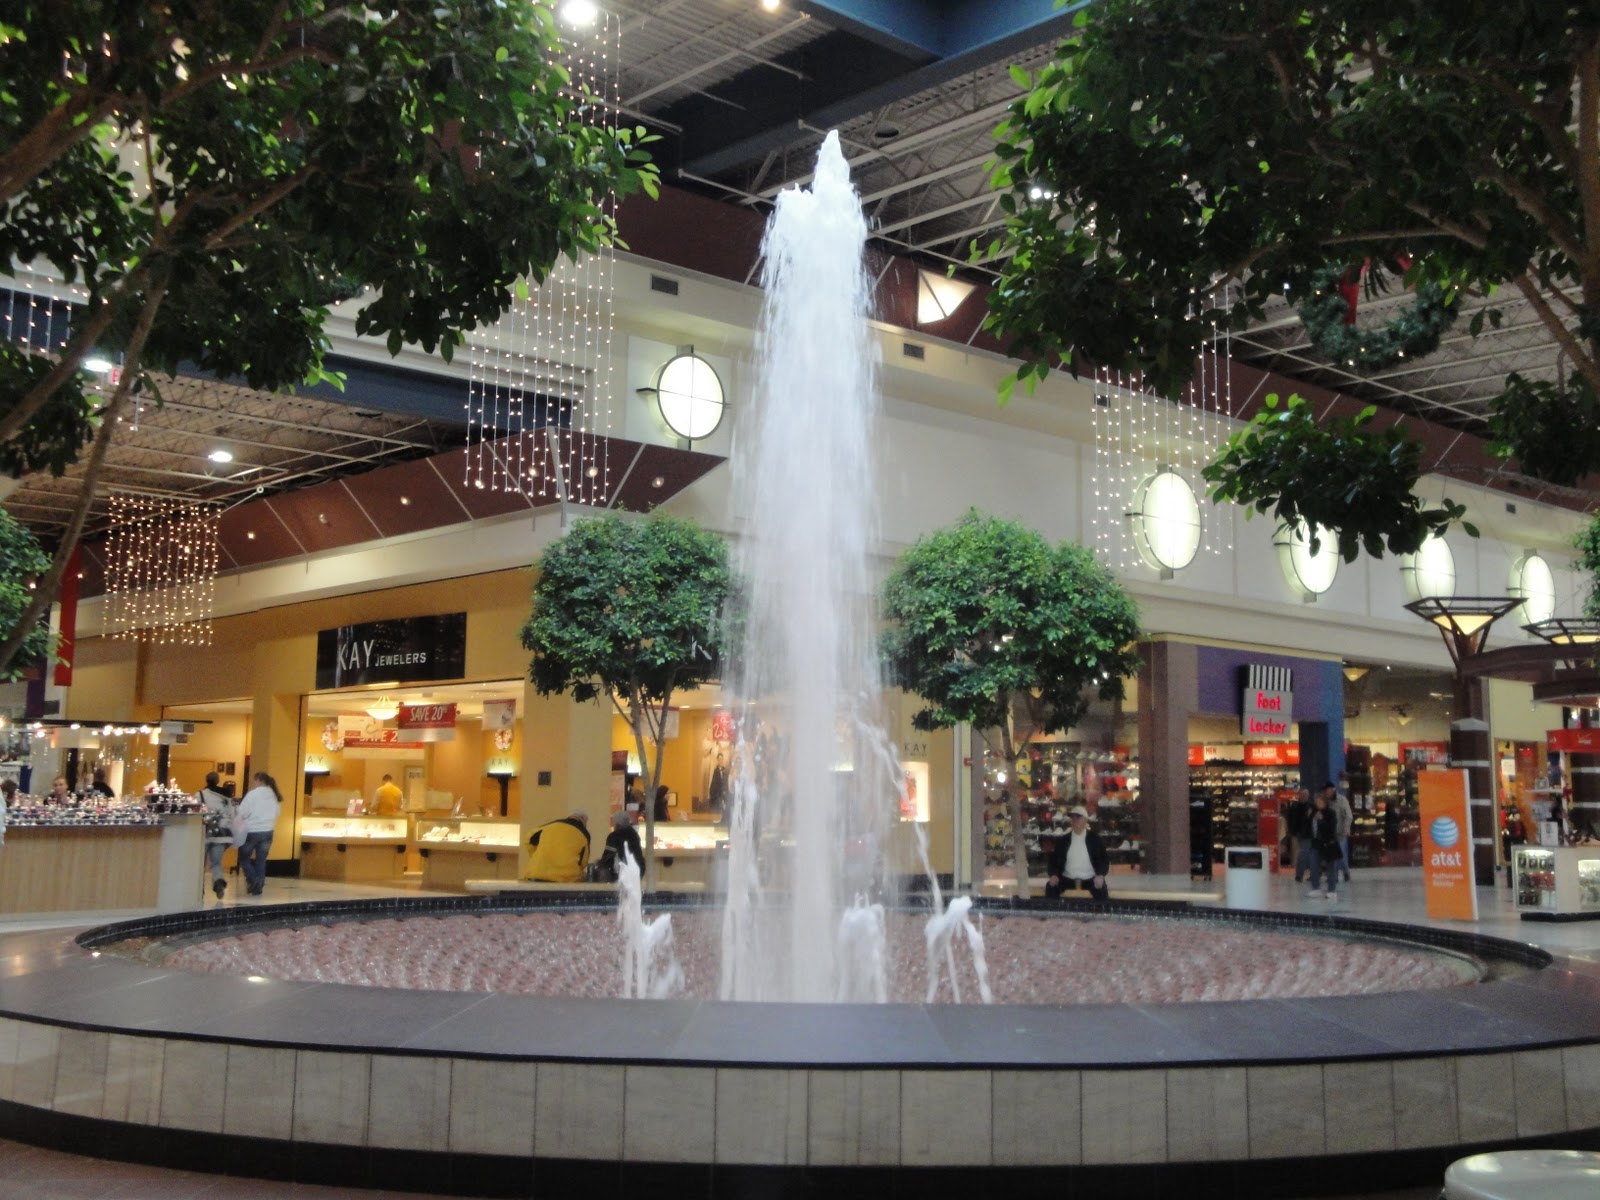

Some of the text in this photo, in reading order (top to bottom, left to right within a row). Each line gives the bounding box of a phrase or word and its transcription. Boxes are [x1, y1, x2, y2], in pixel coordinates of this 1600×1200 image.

[338, 639, 427, 671] KAY JEWELERS
[1257, 691, 1280, 710] Foot
[410, 706, 430, 721] SAVE
[1250, 717, 1286, 734] Locker
[306, 755, 324, 765] AY
[1431, 851, 1462, 866] at&t
